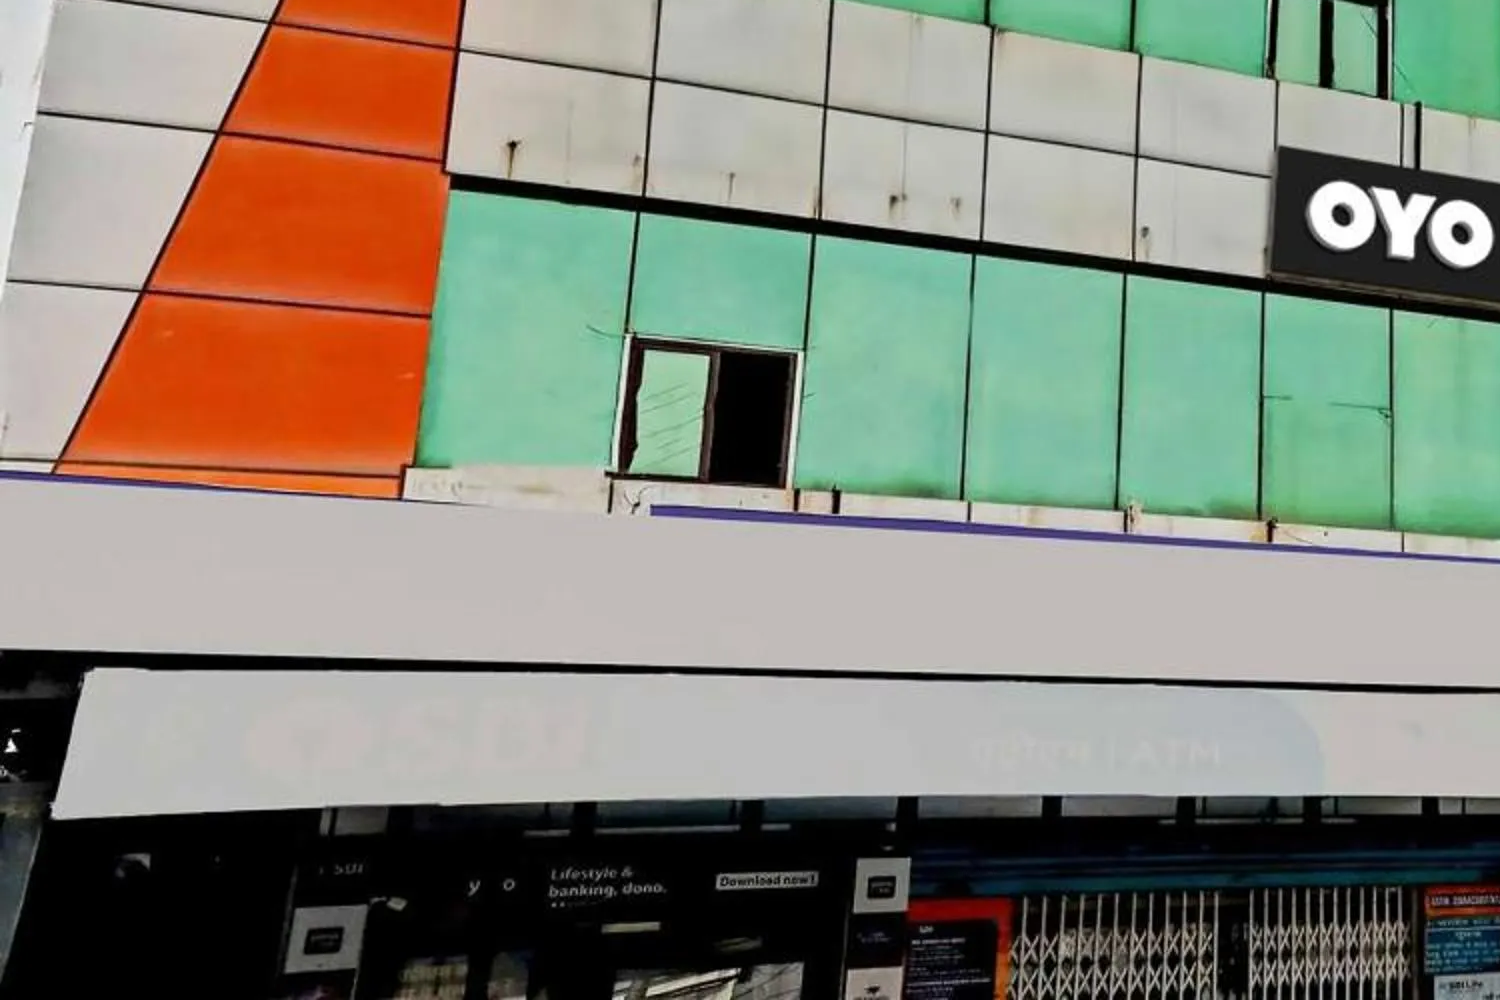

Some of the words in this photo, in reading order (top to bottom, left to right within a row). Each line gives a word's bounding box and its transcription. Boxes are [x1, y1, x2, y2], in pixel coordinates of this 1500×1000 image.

[1305, 180, 1494, 269] OYO
[551, 867, 618, 882] Lifestyle
[620, 866, 634, 878] &
[720, 875, 780, 887] Download
[548, 883, 618, 899] banking,
